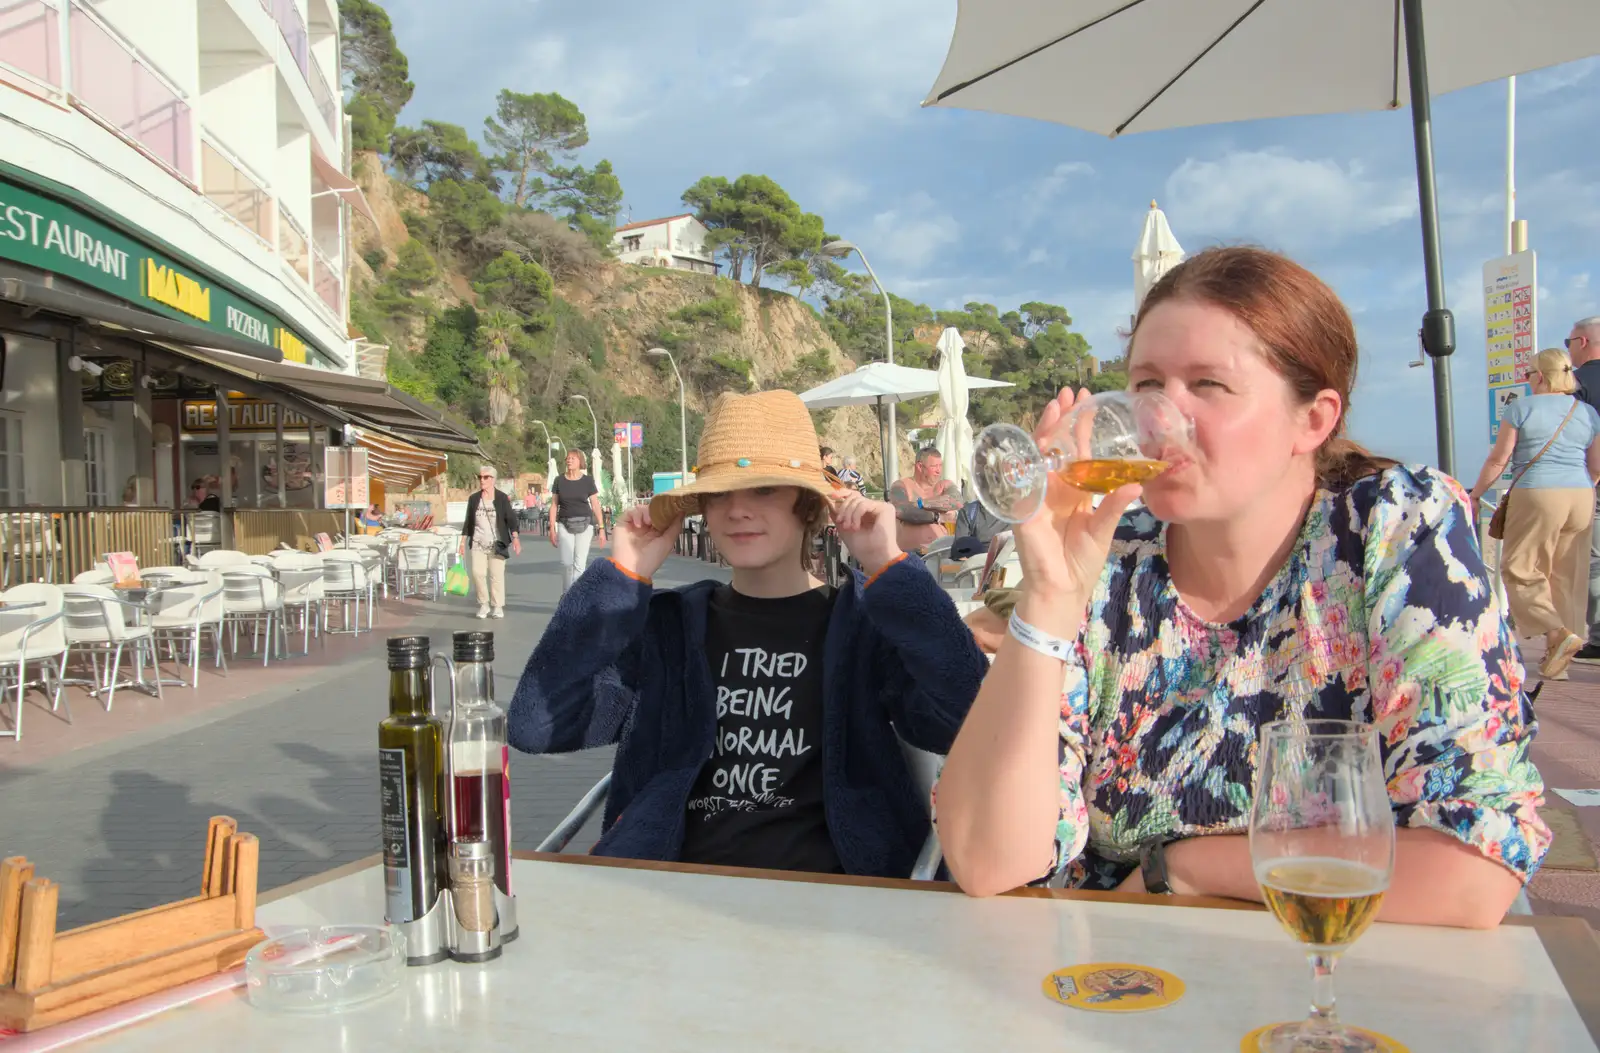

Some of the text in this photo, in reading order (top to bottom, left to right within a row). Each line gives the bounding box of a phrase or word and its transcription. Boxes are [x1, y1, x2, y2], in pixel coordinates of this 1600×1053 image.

[721, 647, 808, 678] I TRIED
[716, 685, 794, 720] BEING
